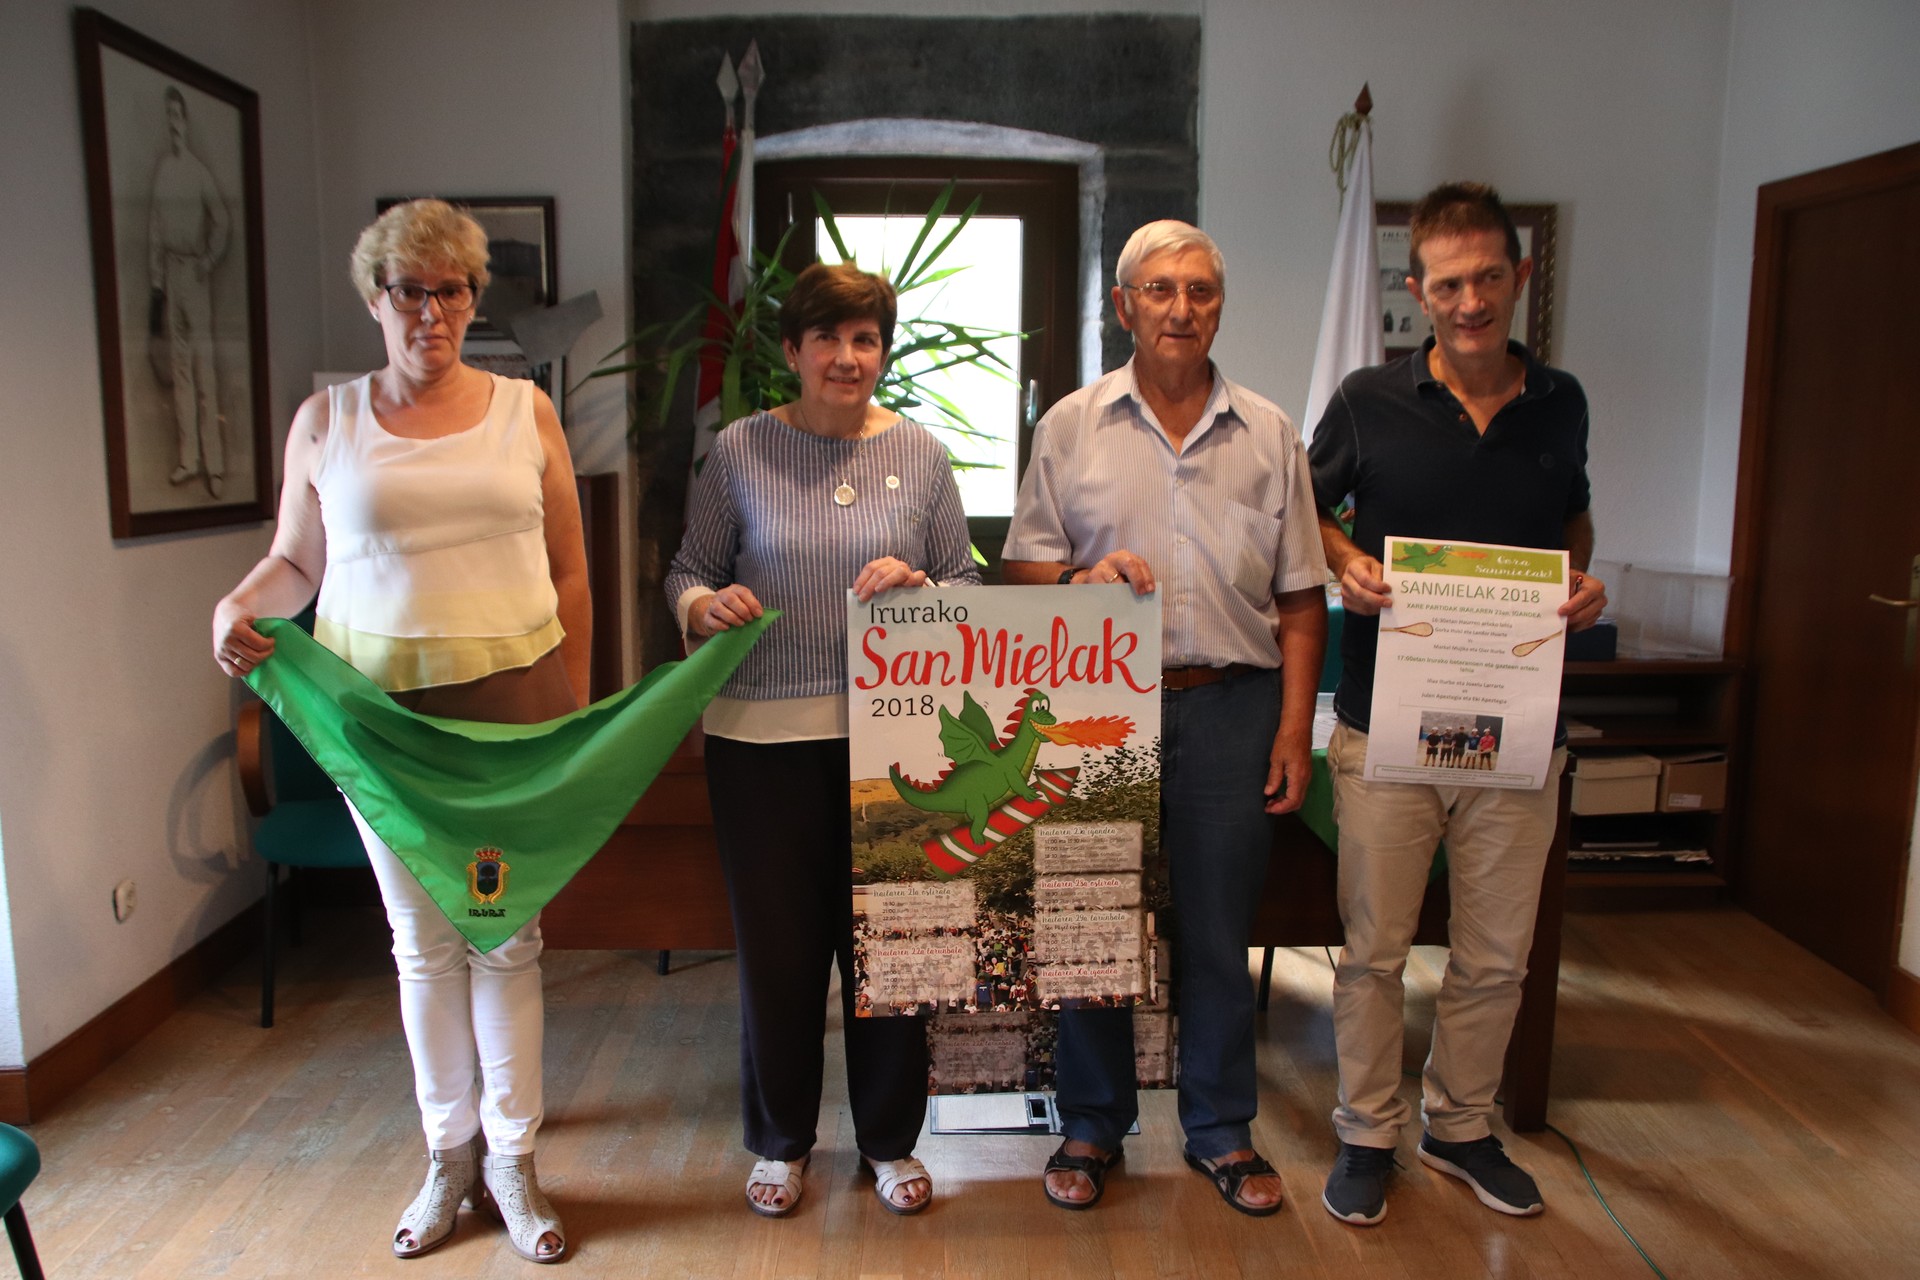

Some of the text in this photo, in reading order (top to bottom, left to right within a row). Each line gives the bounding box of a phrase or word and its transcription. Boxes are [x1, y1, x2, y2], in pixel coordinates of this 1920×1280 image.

[1400, 579, 1541, 604] SANMIELAK 2018
[870, 600, 969, 624] Irurako
[871, 694, 935, 718] 2018
[468, 908, 506, 918] IRURA
